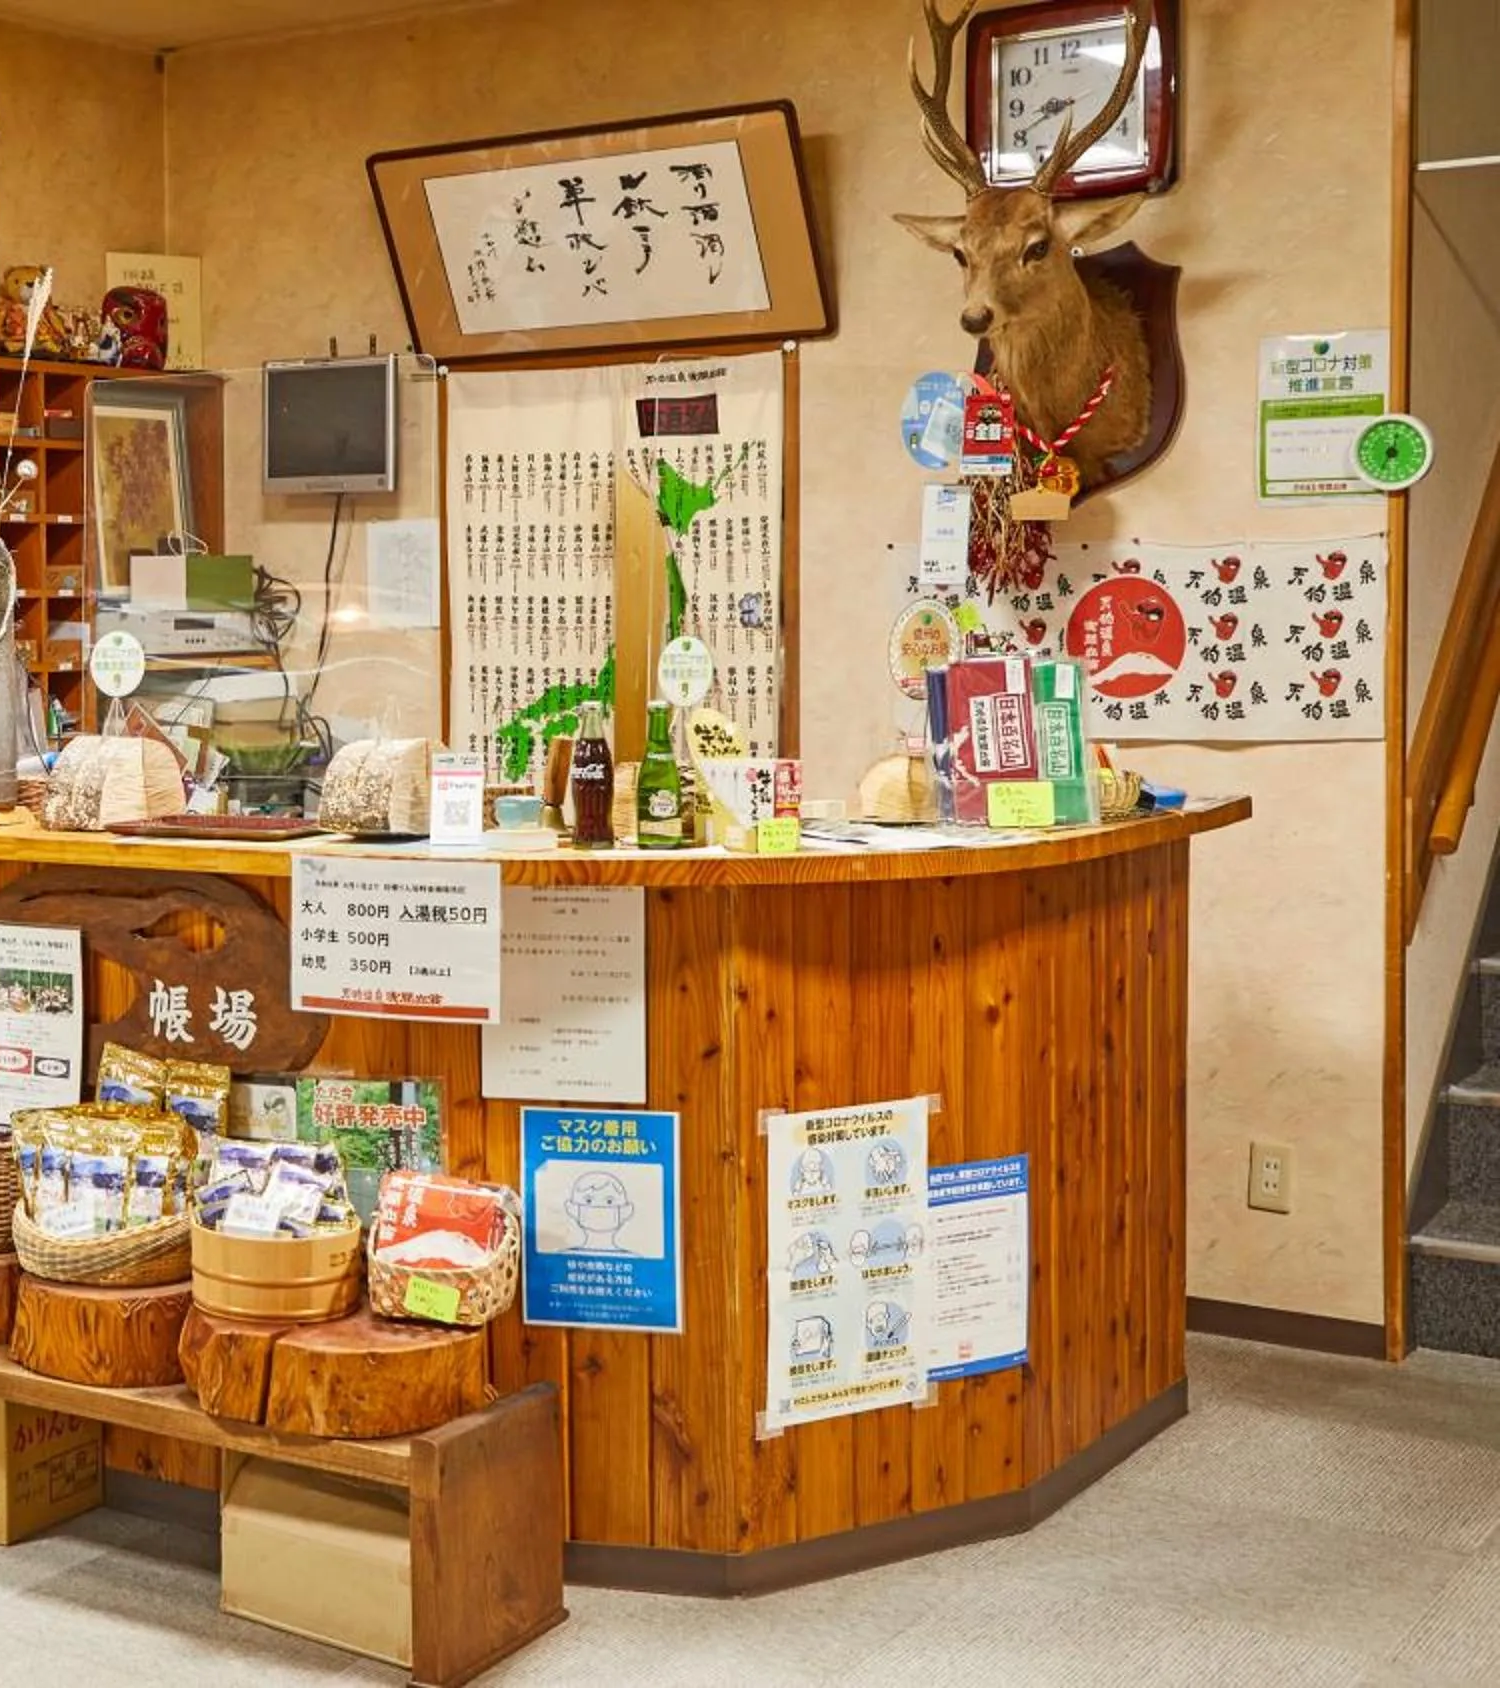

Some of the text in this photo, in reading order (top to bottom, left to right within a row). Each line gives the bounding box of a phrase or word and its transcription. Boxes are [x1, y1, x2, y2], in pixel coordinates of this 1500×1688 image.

[1033, 47, 1049, 65] 11
[1060, 40, 1080, 60] 12
[1010, 67, 1032, 87] 10
[1010, 99, 1024, 118] 9
[1116, 116, 1129, 136] 4
[1013, 129, 1028, 148] 8
[1288, 375, 1354, 393] 推進宣言
[998, 699, 1022, 764] 日本百名山
[301, 901, 487, 923] 大人 800円 入湯税50円
[301, 928, 389, 947] 小学生 500円
[301, 956, 327, 970] 幼児
[350, 959, 391, 974] 350円
[149, 980, 258, 1051] 帳場
[313, 1103, 427, 1130] 好評発売中
[558, 1119, 637, 1136] マスク着用
[540, 1135, 657, 1156] ご協力のお願い
